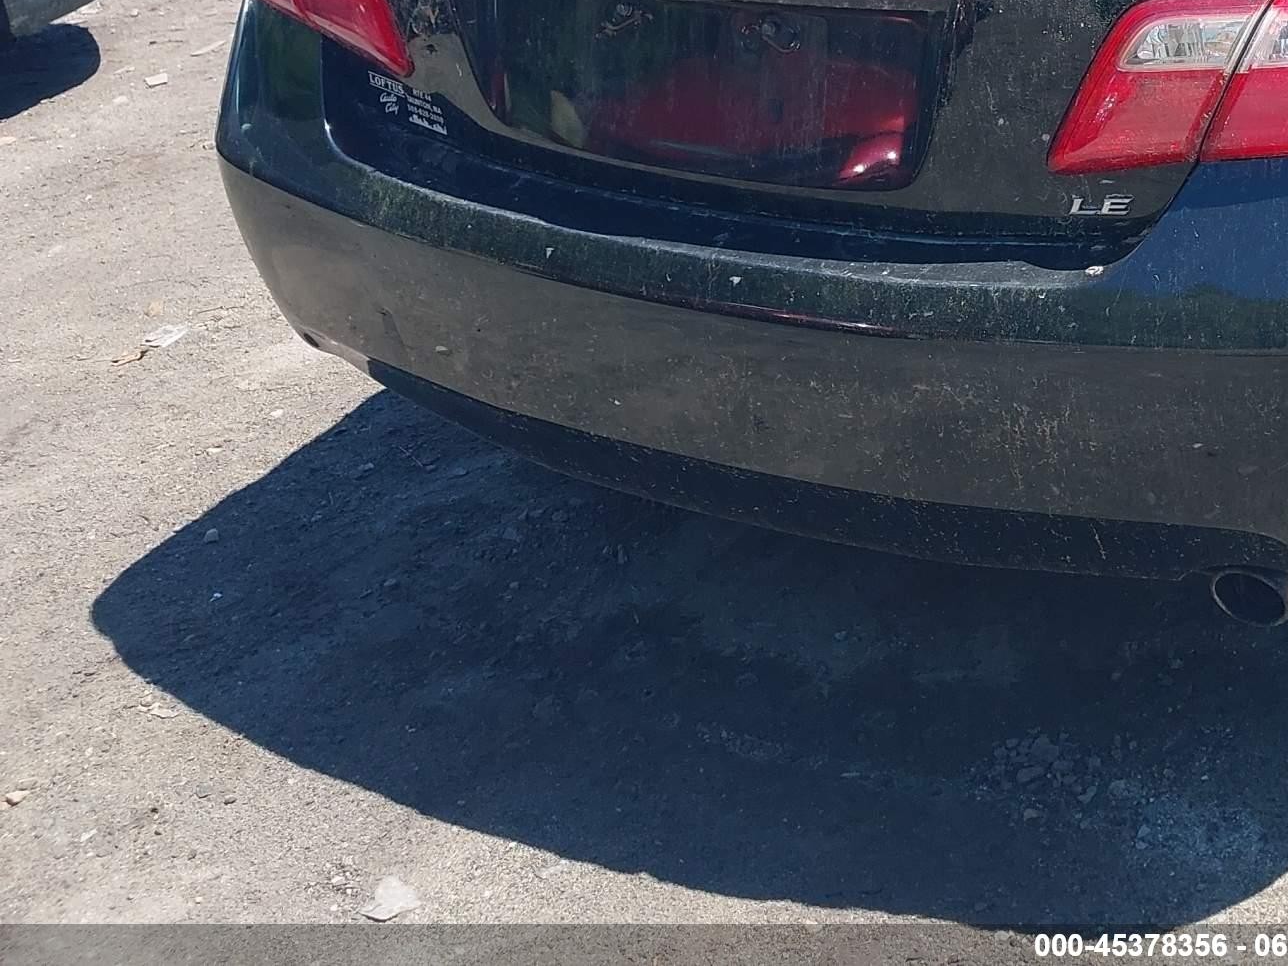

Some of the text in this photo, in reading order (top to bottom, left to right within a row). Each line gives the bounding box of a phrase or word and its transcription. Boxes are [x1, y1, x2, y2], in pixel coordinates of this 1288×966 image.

[368, 73, 405, 94] LOFTUS
[380, 92, 397, 103] Auto
[385, 102, 399, 115] City
[1069, 194, 1135, 216] LE
